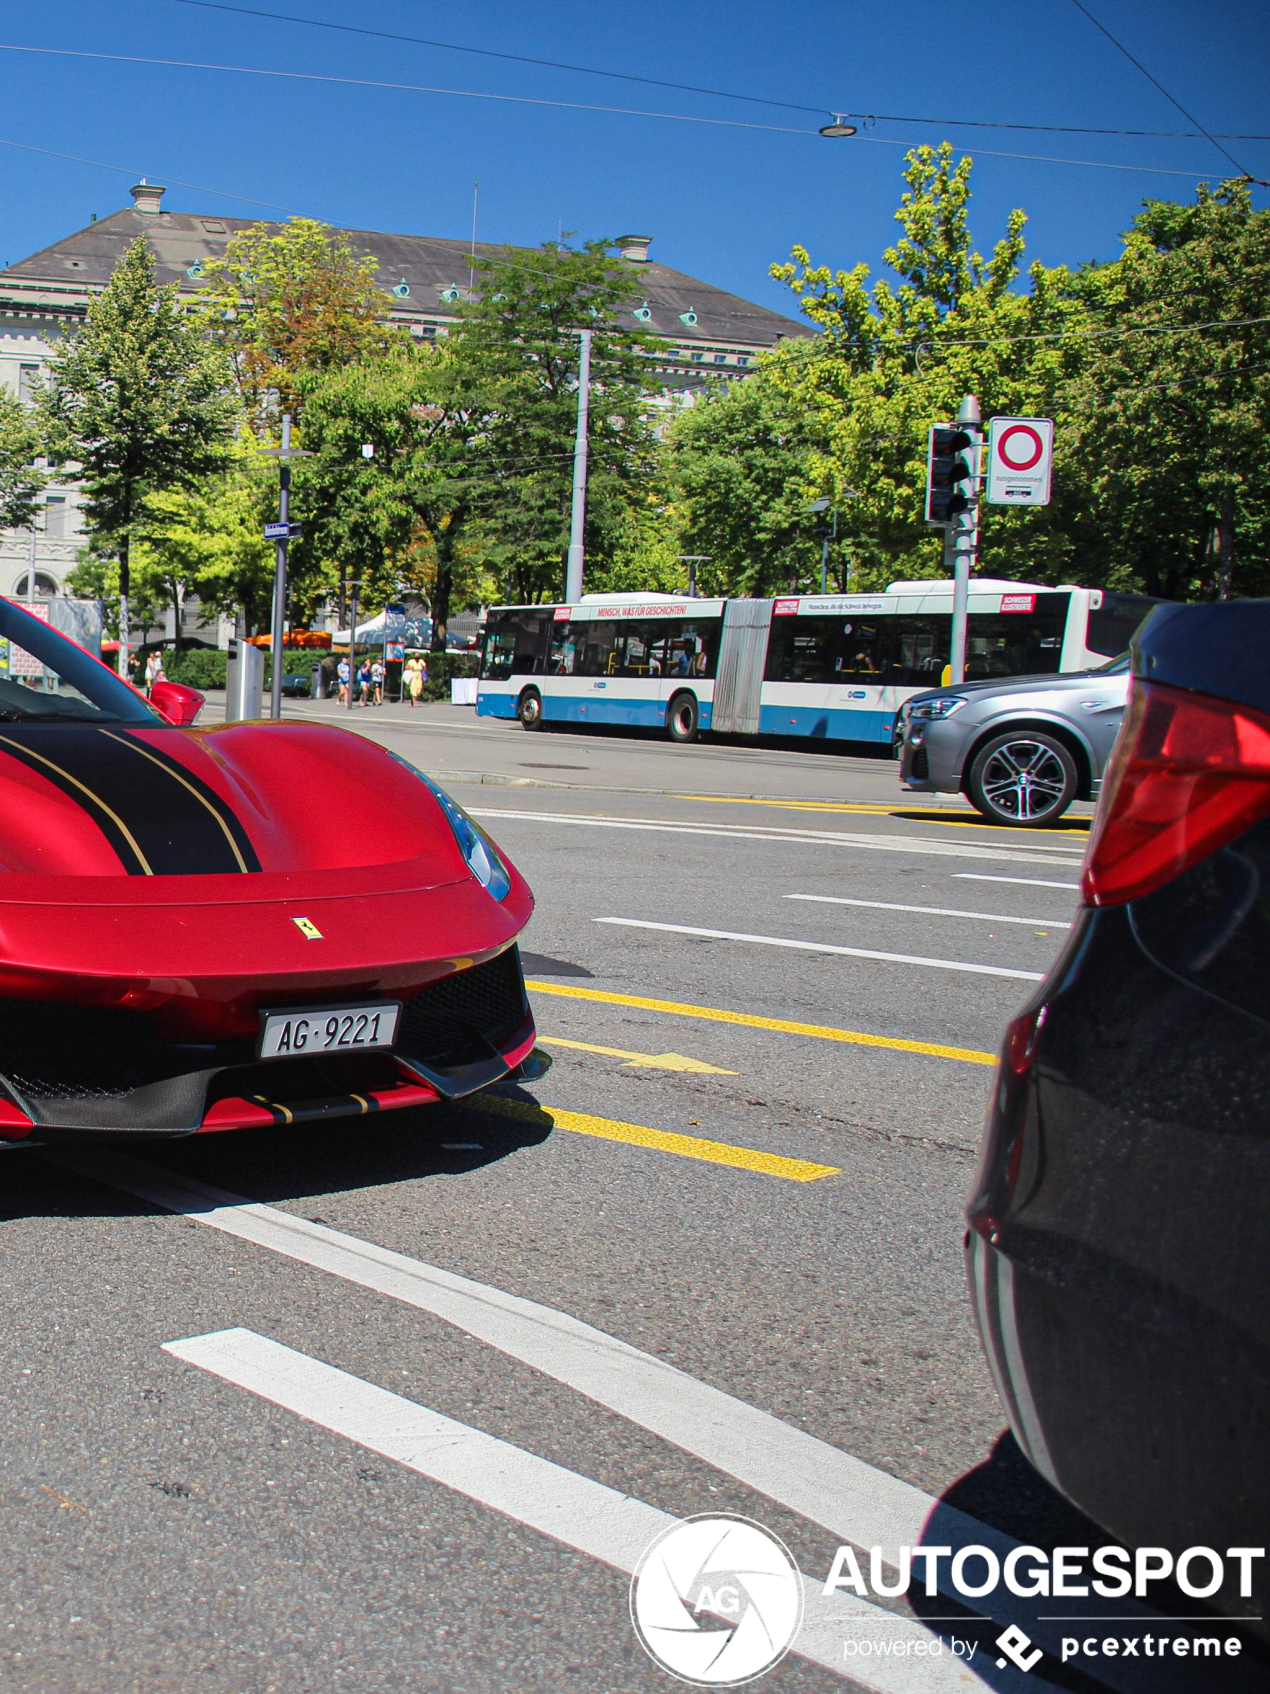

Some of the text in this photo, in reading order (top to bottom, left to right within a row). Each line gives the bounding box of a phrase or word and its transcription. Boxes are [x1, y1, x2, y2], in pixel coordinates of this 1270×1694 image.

[995, 475, 1042, 483] ausgenommen
[622, 607, 635, 616] WAS
[635, 604, 645, 616] FÜR
